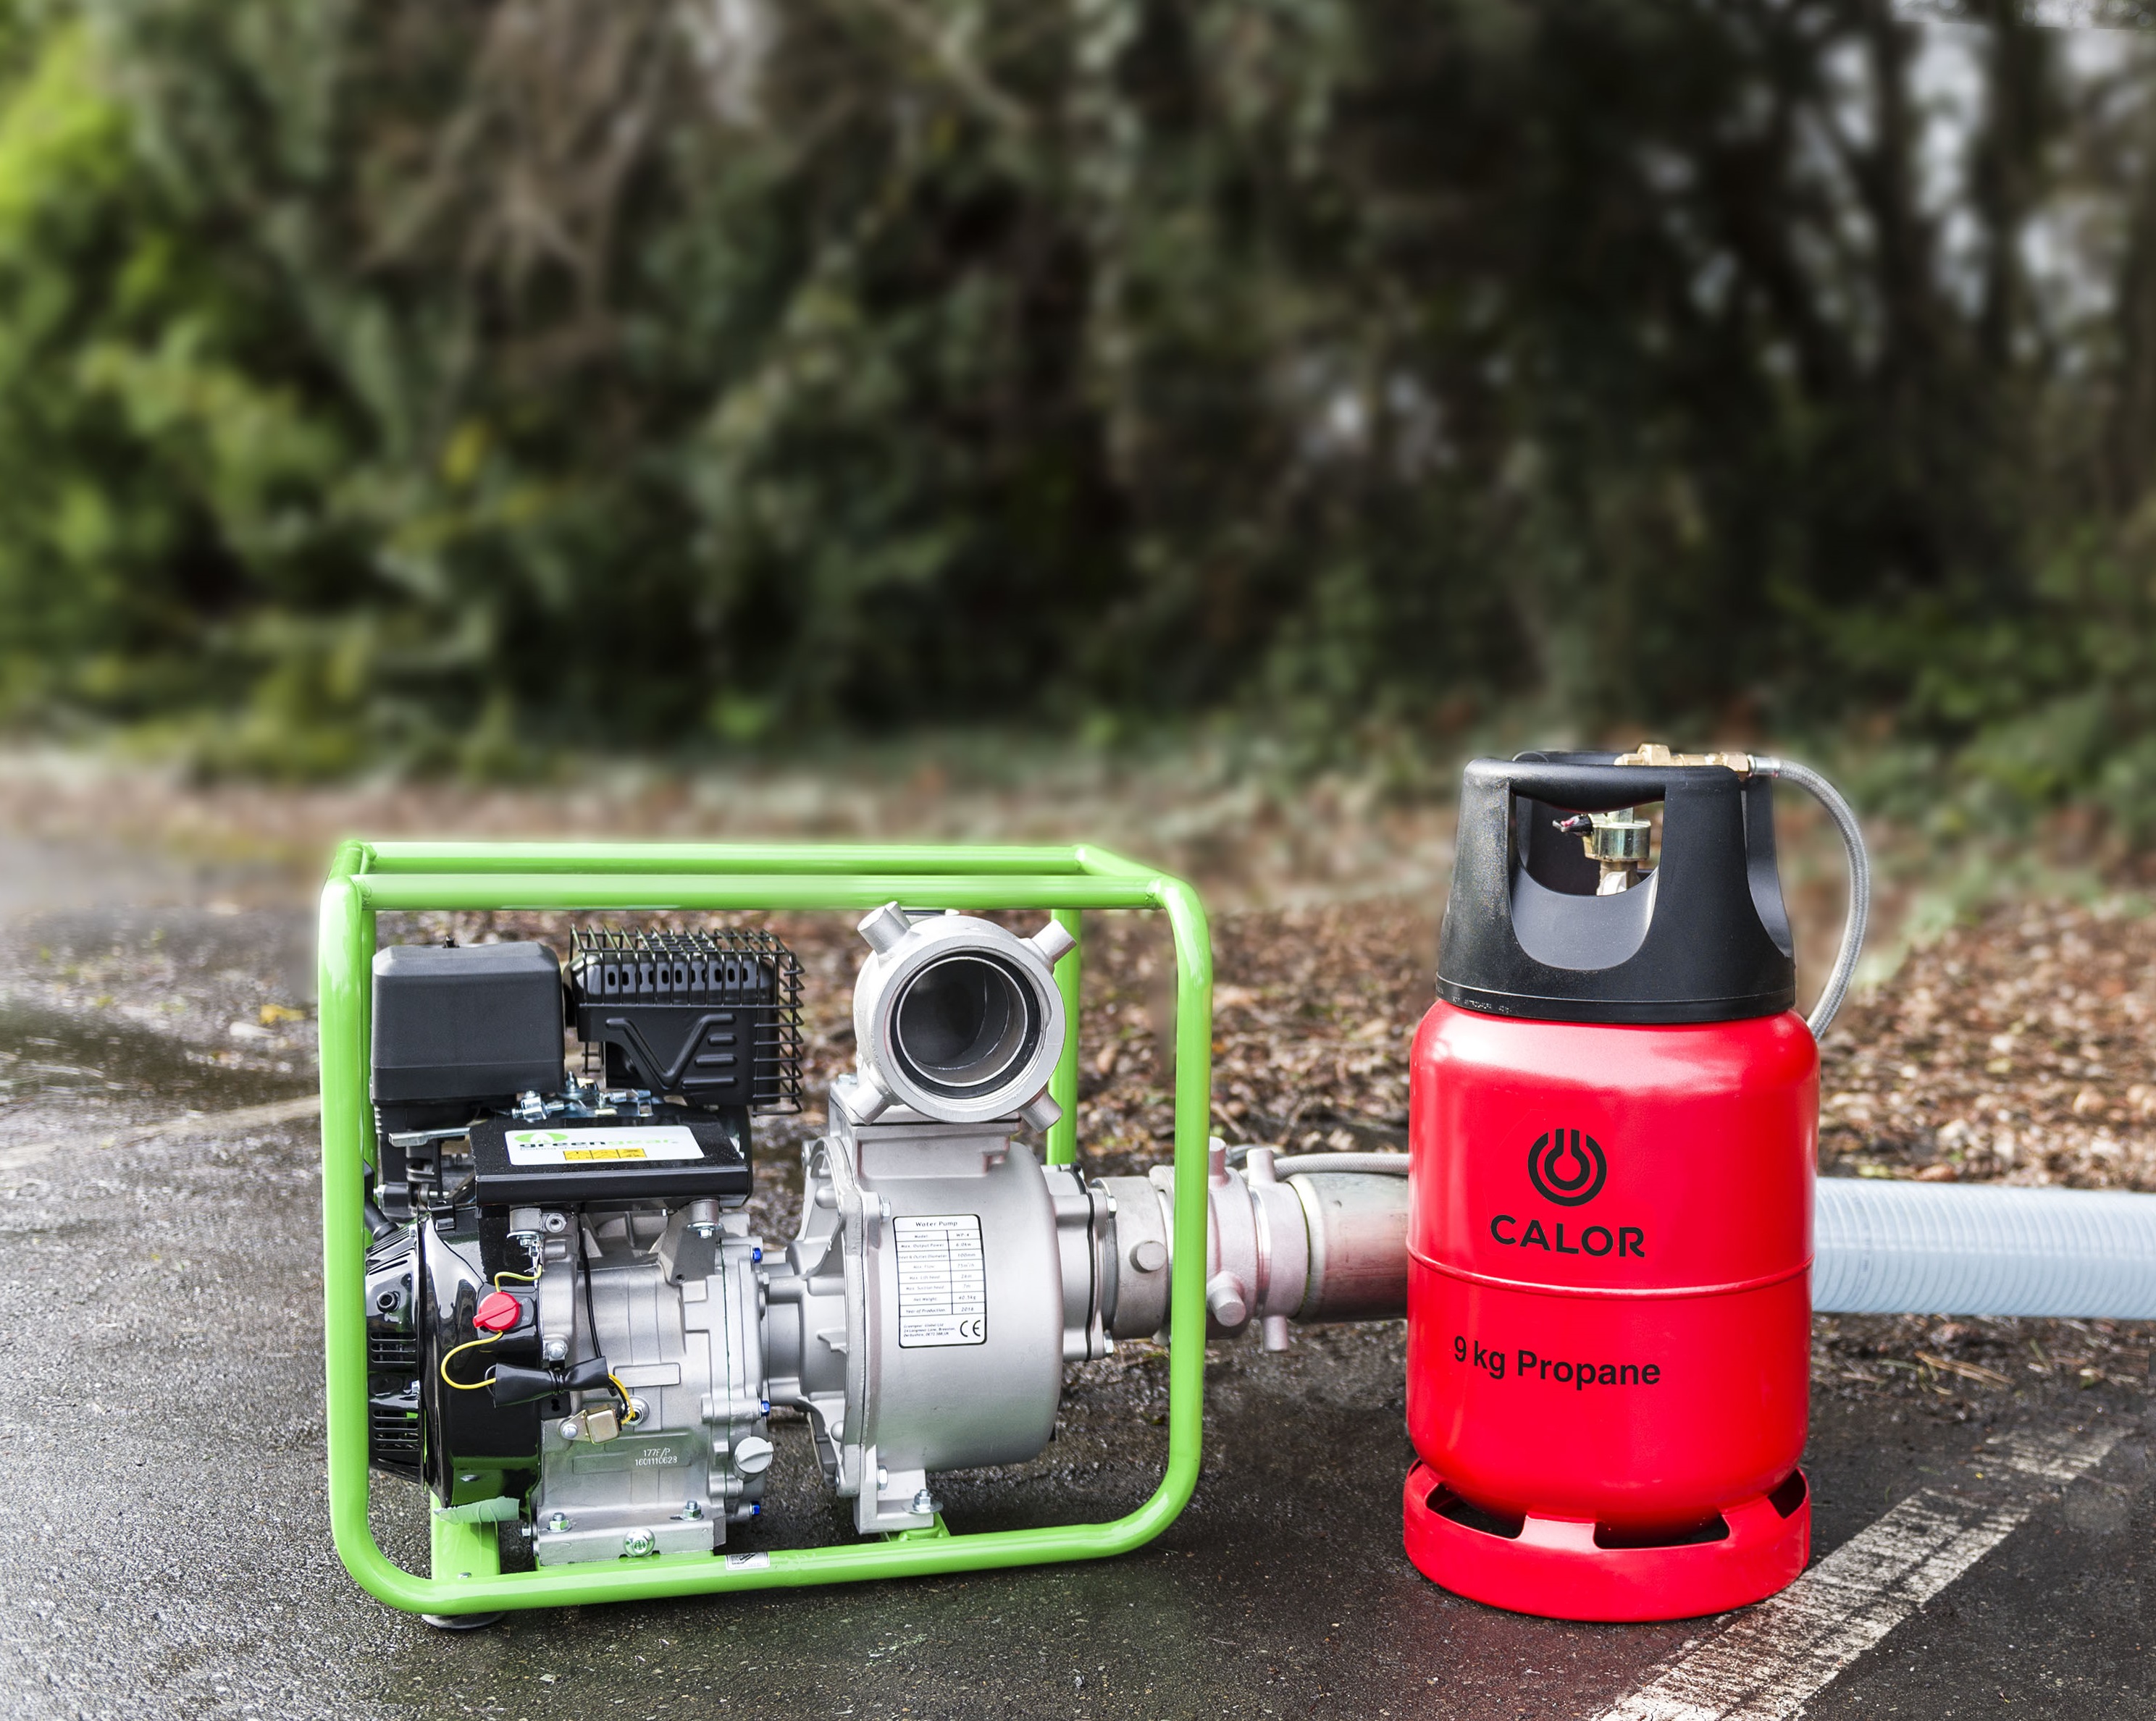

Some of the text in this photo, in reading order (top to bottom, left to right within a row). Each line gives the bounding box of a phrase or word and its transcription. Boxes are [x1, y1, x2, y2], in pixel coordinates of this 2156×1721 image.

[1490, 1214, 1645, 1258] CALOR
[960, 1320, 981, 1338] CE
[1454, 1336, 1661, 1391] 9 kg Propane
